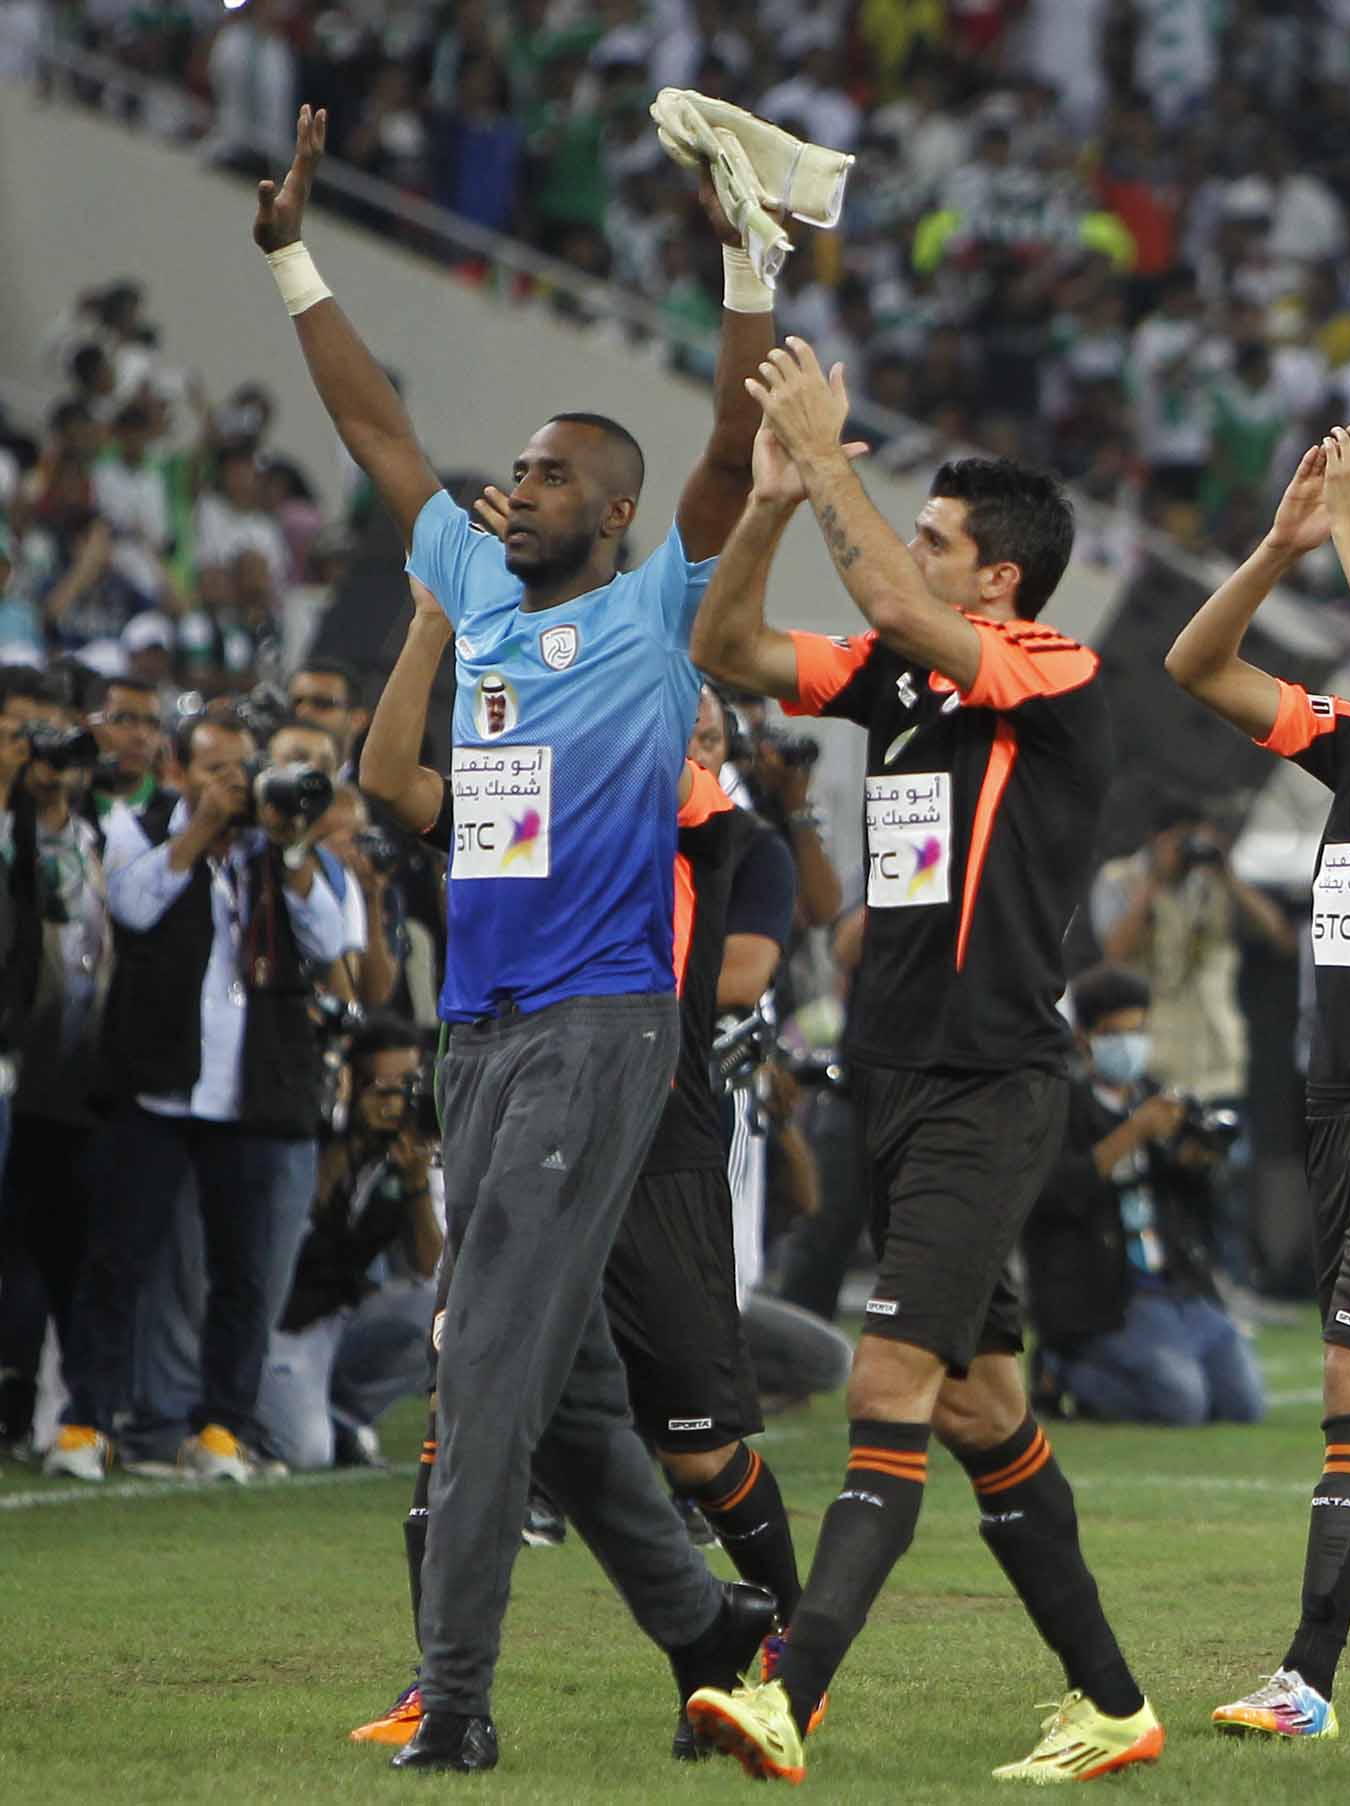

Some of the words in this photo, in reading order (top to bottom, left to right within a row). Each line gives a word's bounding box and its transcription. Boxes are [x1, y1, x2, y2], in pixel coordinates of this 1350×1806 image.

[511, 749, 543, 776] أبو
[485, 778, 541, 800] شعبك
[866, 786, 900, 803] متع
[906, 776, 940, 805] أبو
[882, 804, 941, 830] شعبك
[870, 851, 899, 880] TC
